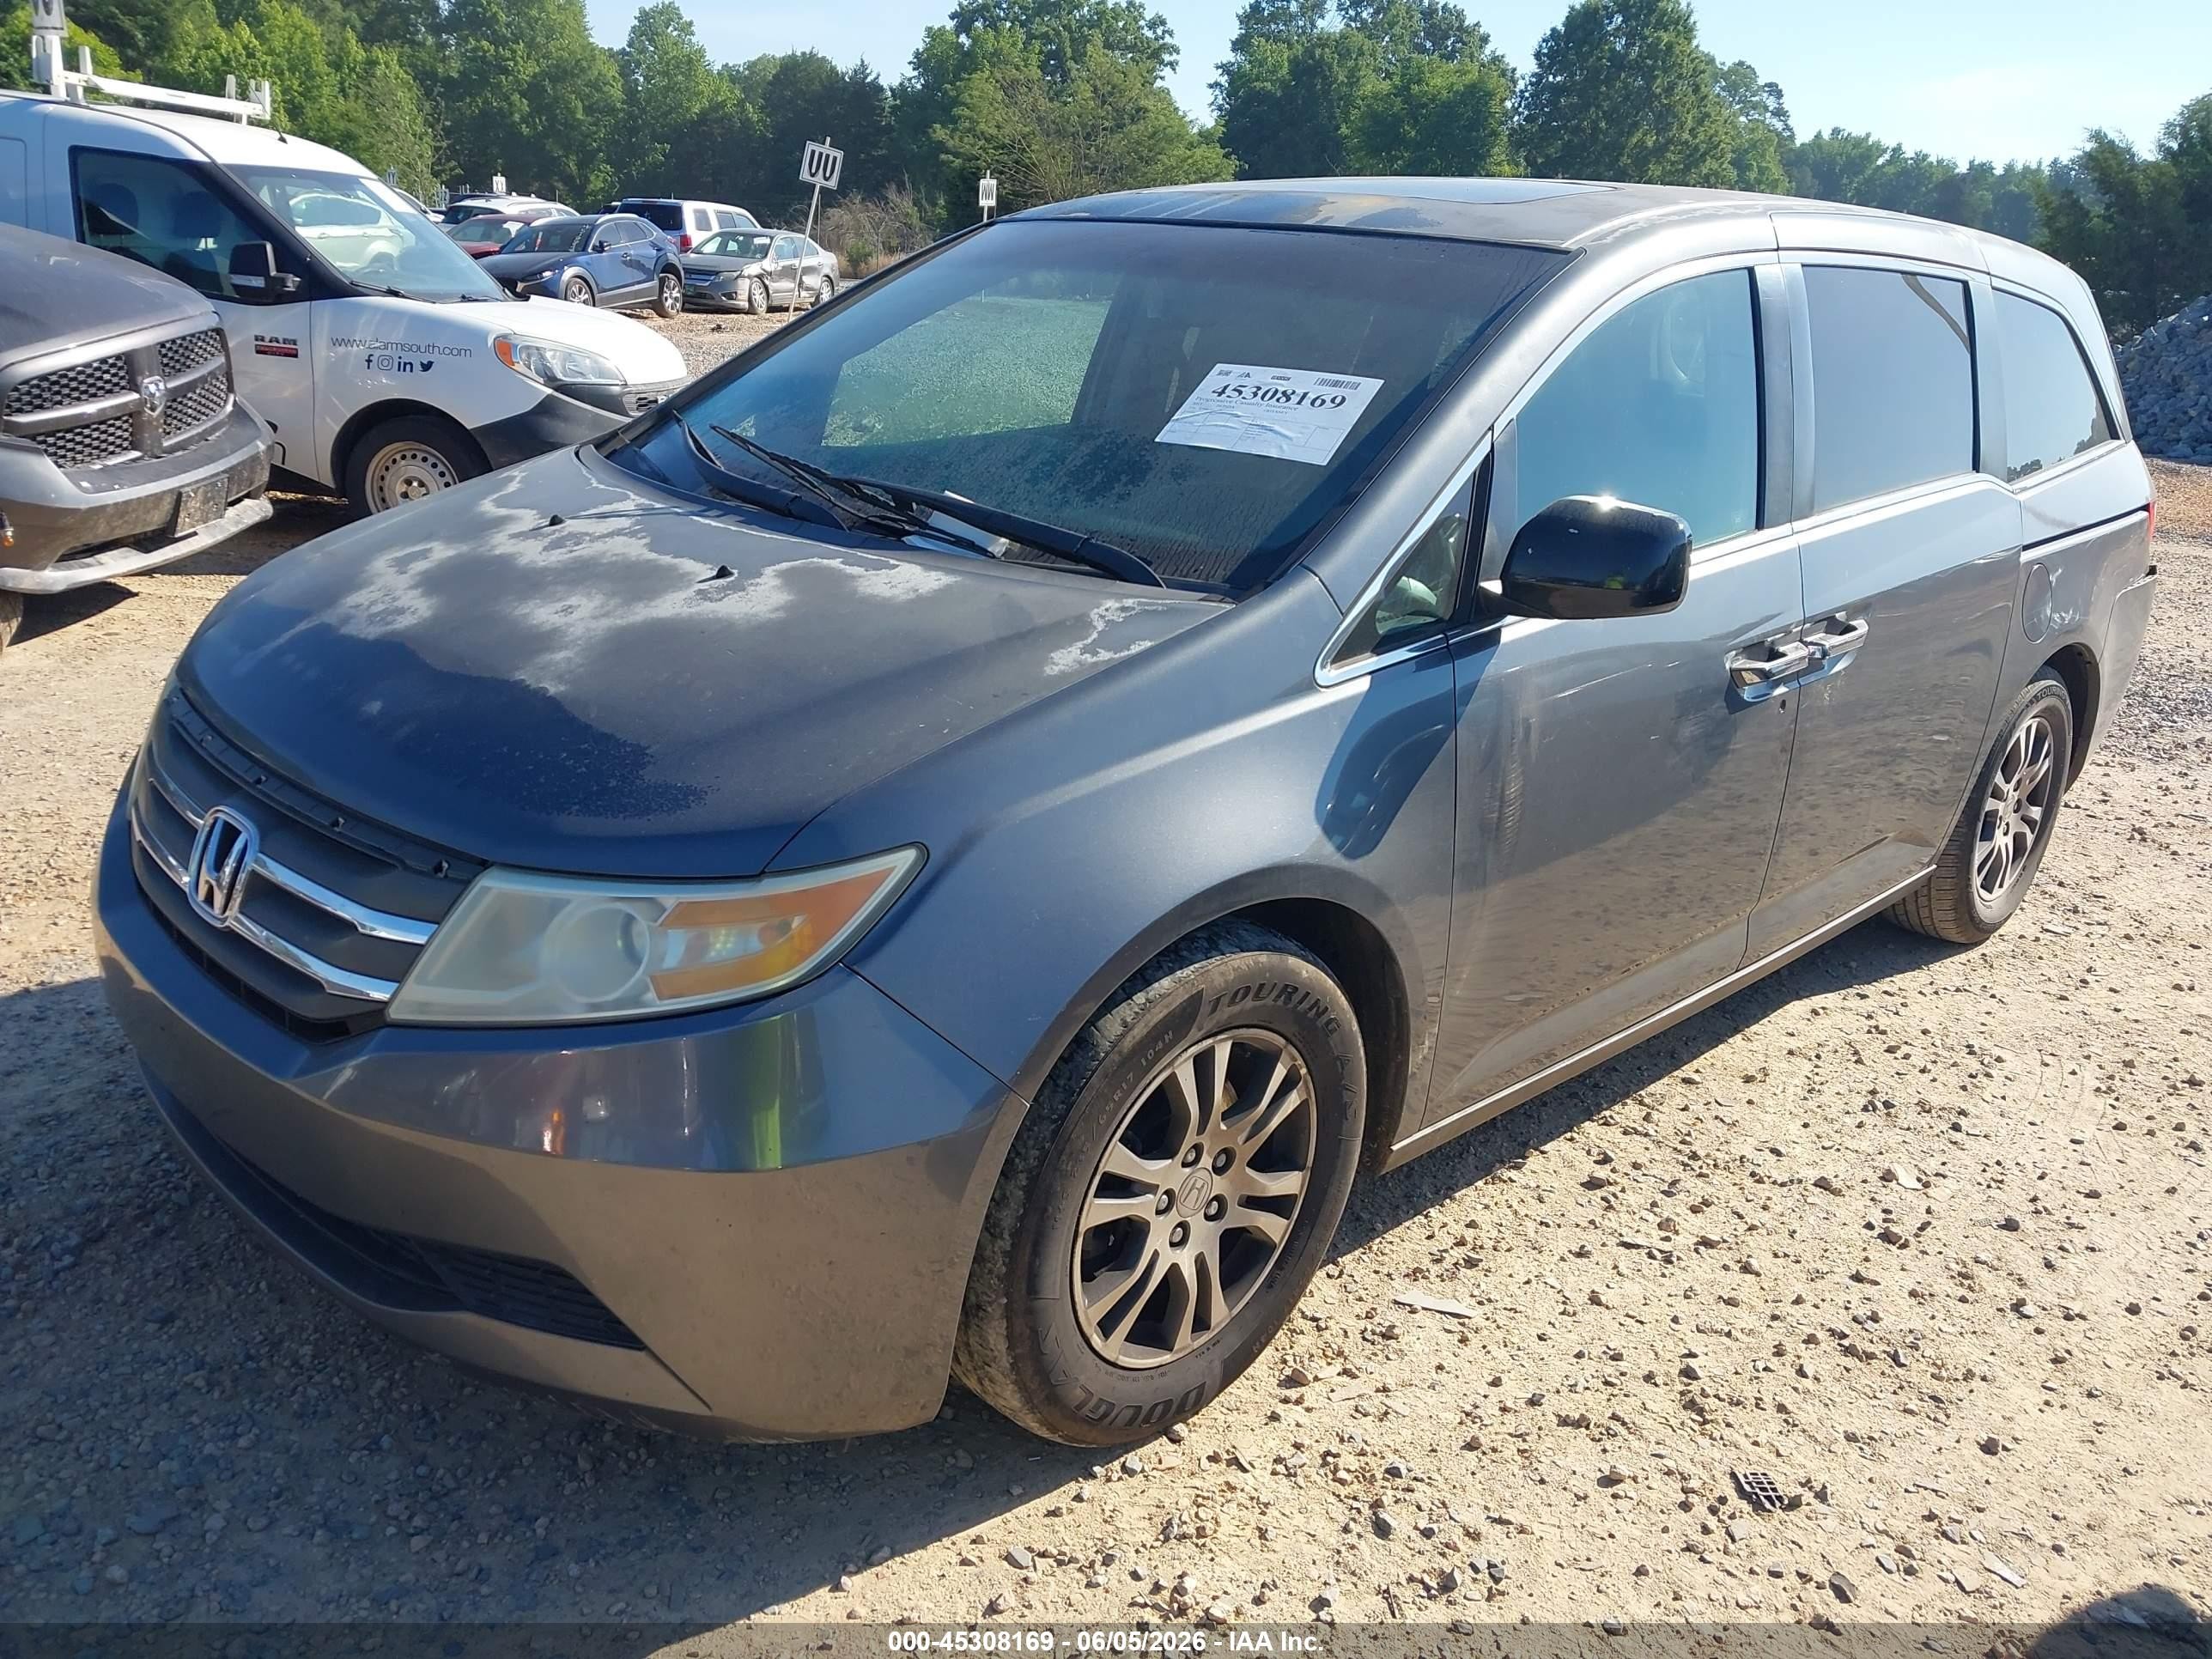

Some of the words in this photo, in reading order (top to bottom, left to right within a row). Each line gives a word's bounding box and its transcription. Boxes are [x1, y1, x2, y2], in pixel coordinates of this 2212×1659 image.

[807, 149, 838, 181] UU
[254, 334, 297, 346] RAM
[331, 336, 472, 358] www.alarmsouth.com
[1211, 383, 1347, 410] 45308169
[1207, 981, 1341, 1038] TOURING
